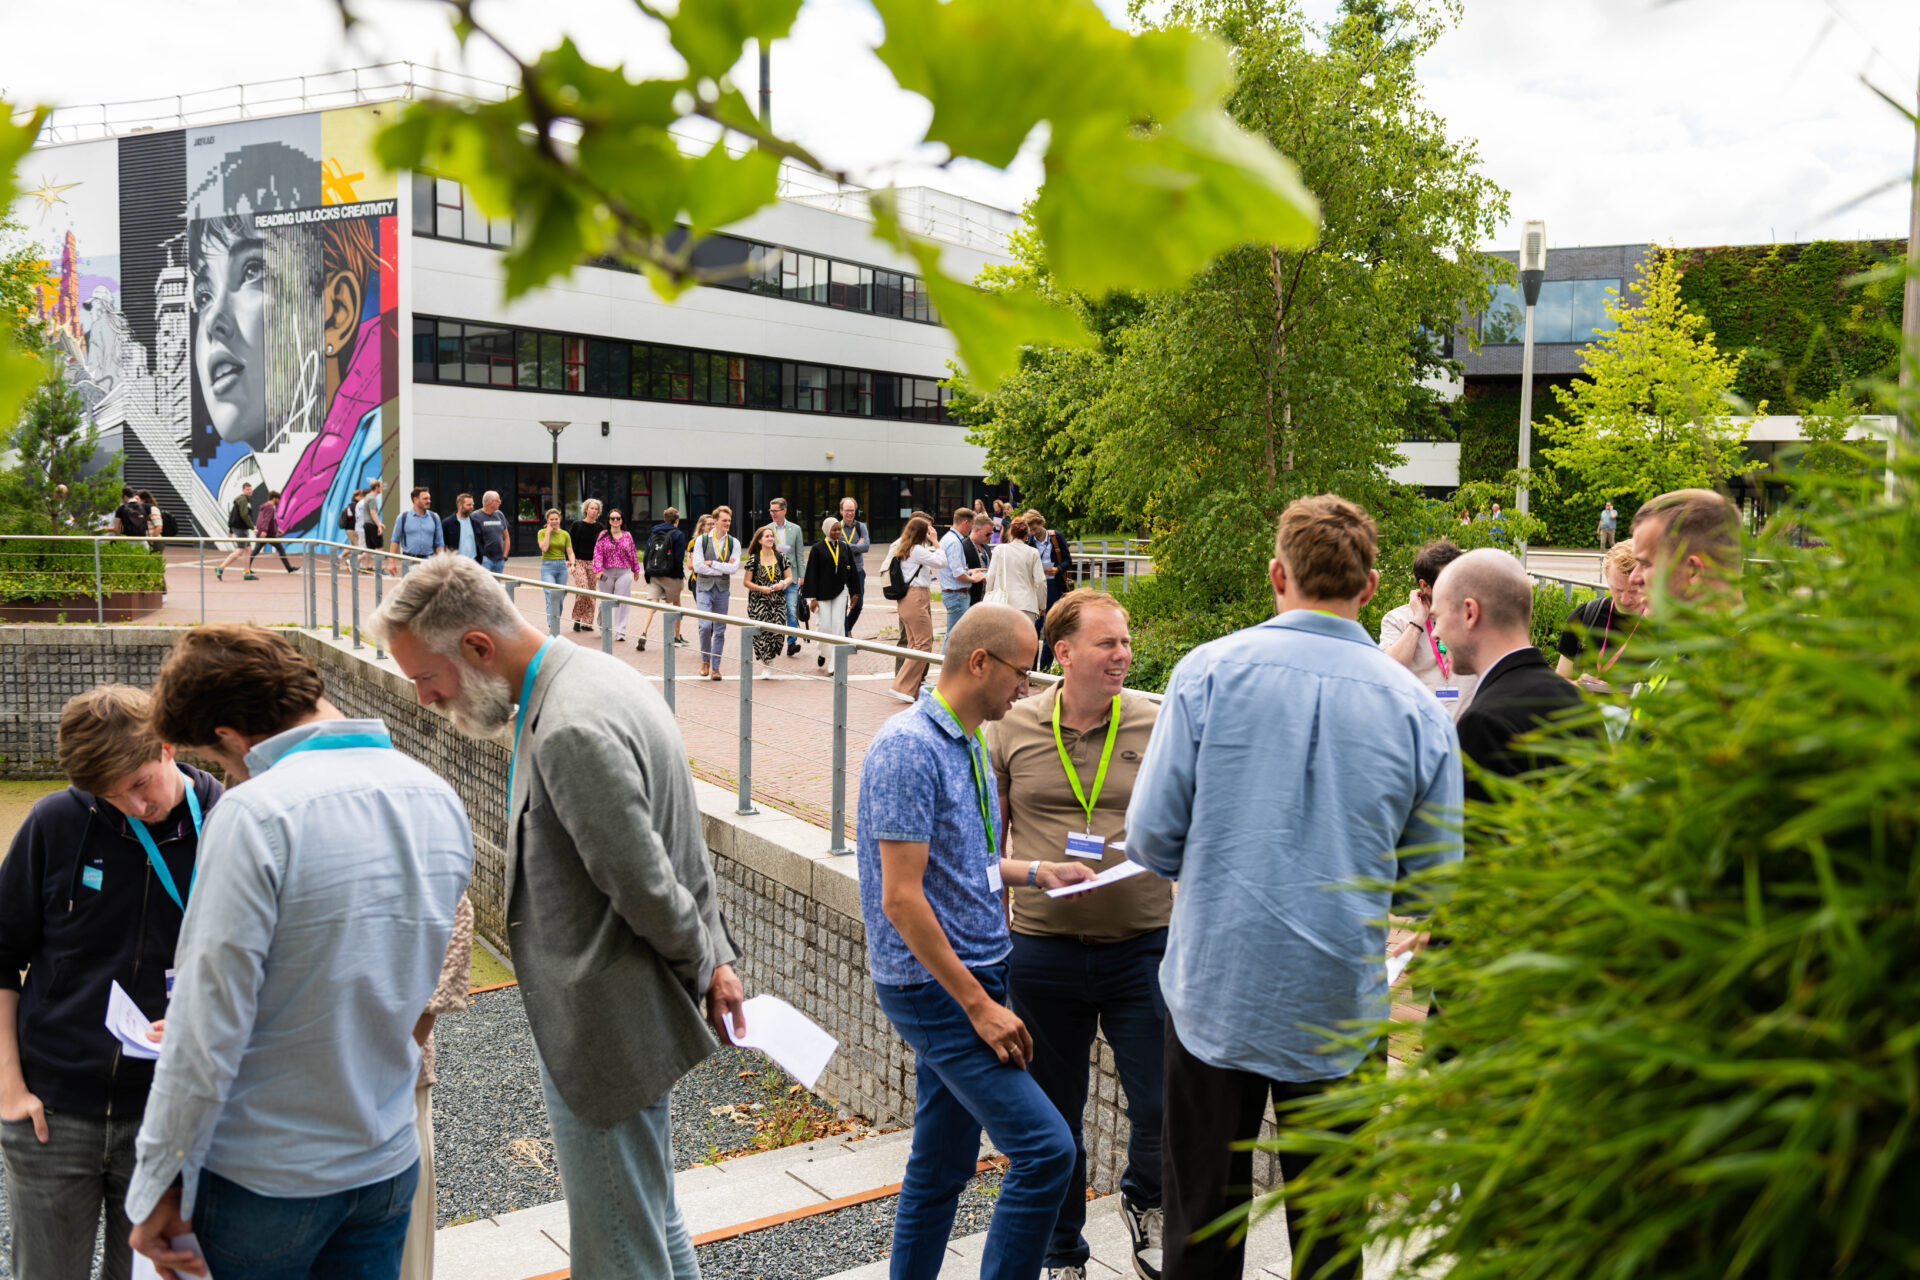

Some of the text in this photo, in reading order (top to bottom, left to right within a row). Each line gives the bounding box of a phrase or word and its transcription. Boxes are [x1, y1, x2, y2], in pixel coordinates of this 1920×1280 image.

[255, 202, 394, 228] READING UNLOCKS CREATIVITY
